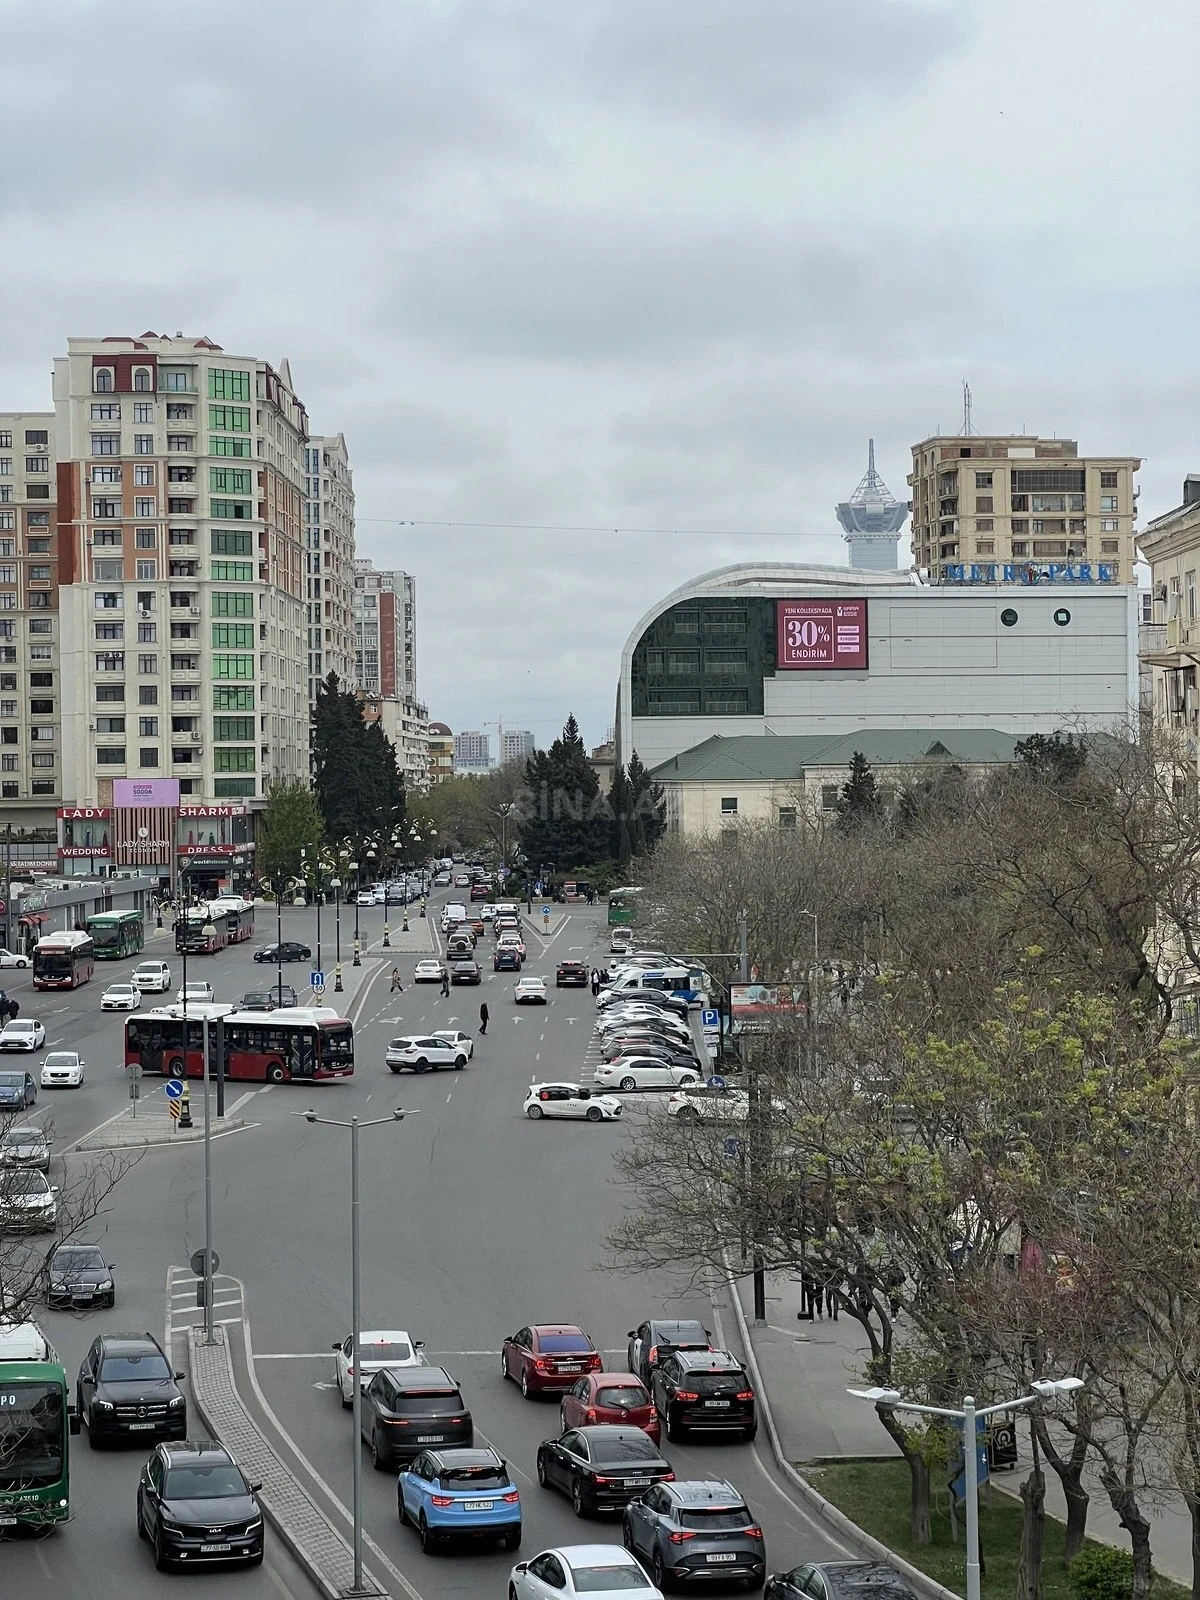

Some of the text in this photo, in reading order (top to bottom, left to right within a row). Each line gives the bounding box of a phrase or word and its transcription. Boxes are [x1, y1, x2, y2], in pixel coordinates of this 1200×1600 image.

[1049, 562, 1112, 582] PARK
[787, 620, 830, 647] 30%
[791, 648, 827, 658] ENDİRİM
[62, 809, 105, 818] LADY
[179, 807, 229, 817] SHARM
[117, 840, 170, 848] LADY SHARM
[187, 846, 224, 854] DRESS
[705, 1011, 715, 1024] P
